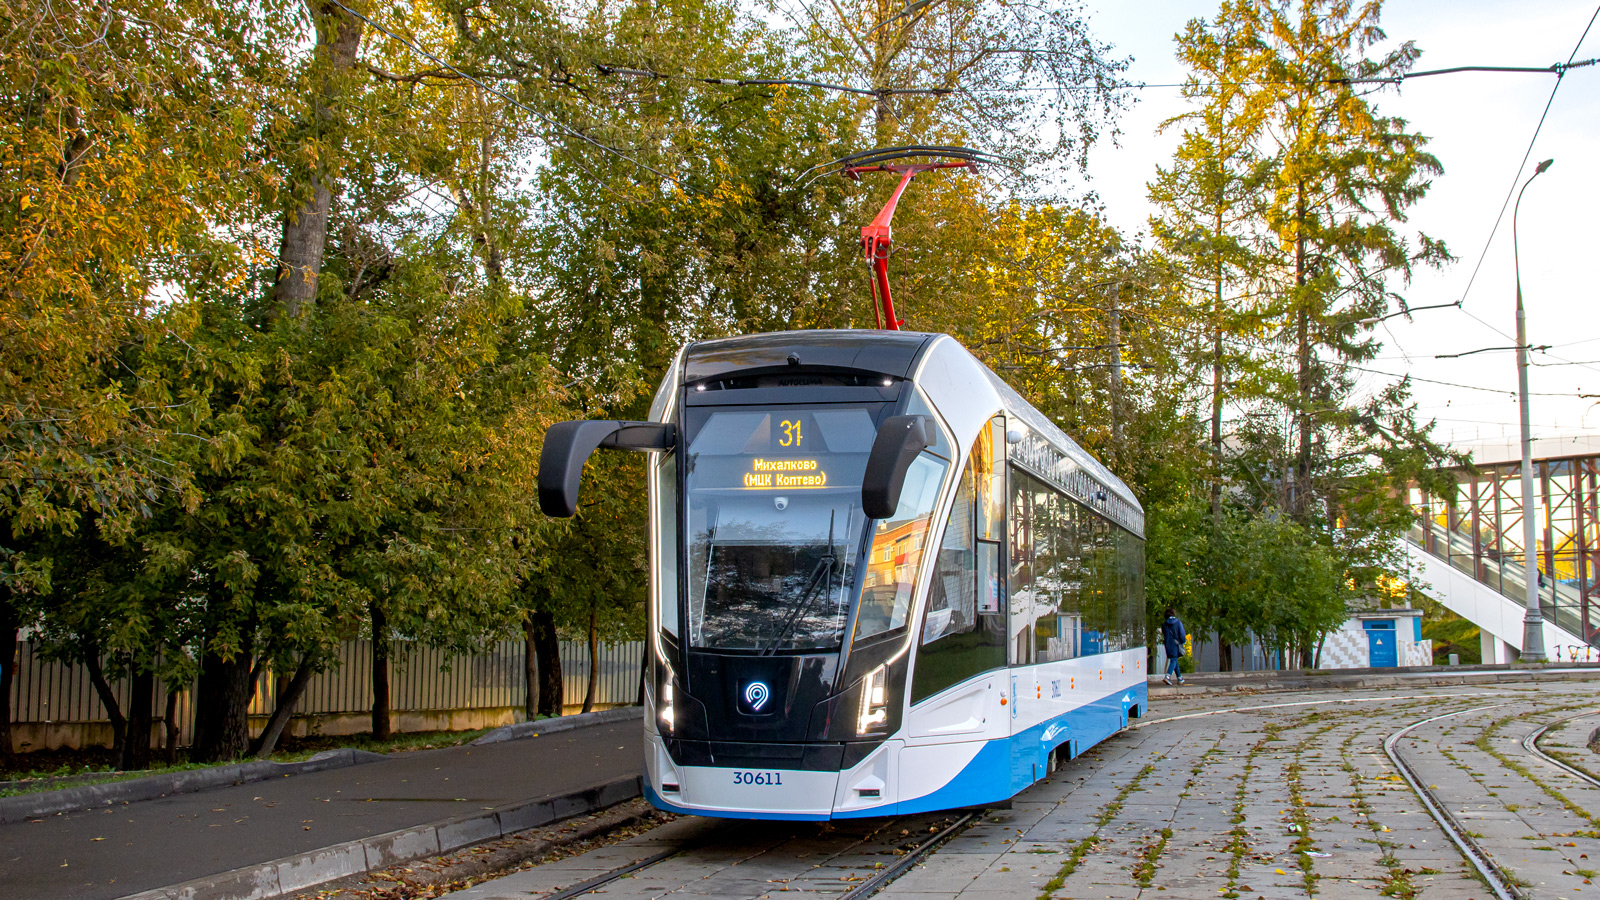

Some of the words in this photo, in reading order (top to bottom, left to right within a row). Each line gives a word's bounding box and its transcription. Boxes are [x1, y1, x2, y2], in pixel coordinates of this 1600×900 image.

[779, 420, 803, 447] 31
[753, 458, 818, 471] Михалково
[743, 472, 773, 487] (МЦК
[776, 471, 827, 486] Коптево)
[733, 771, 782, 785] 30611
